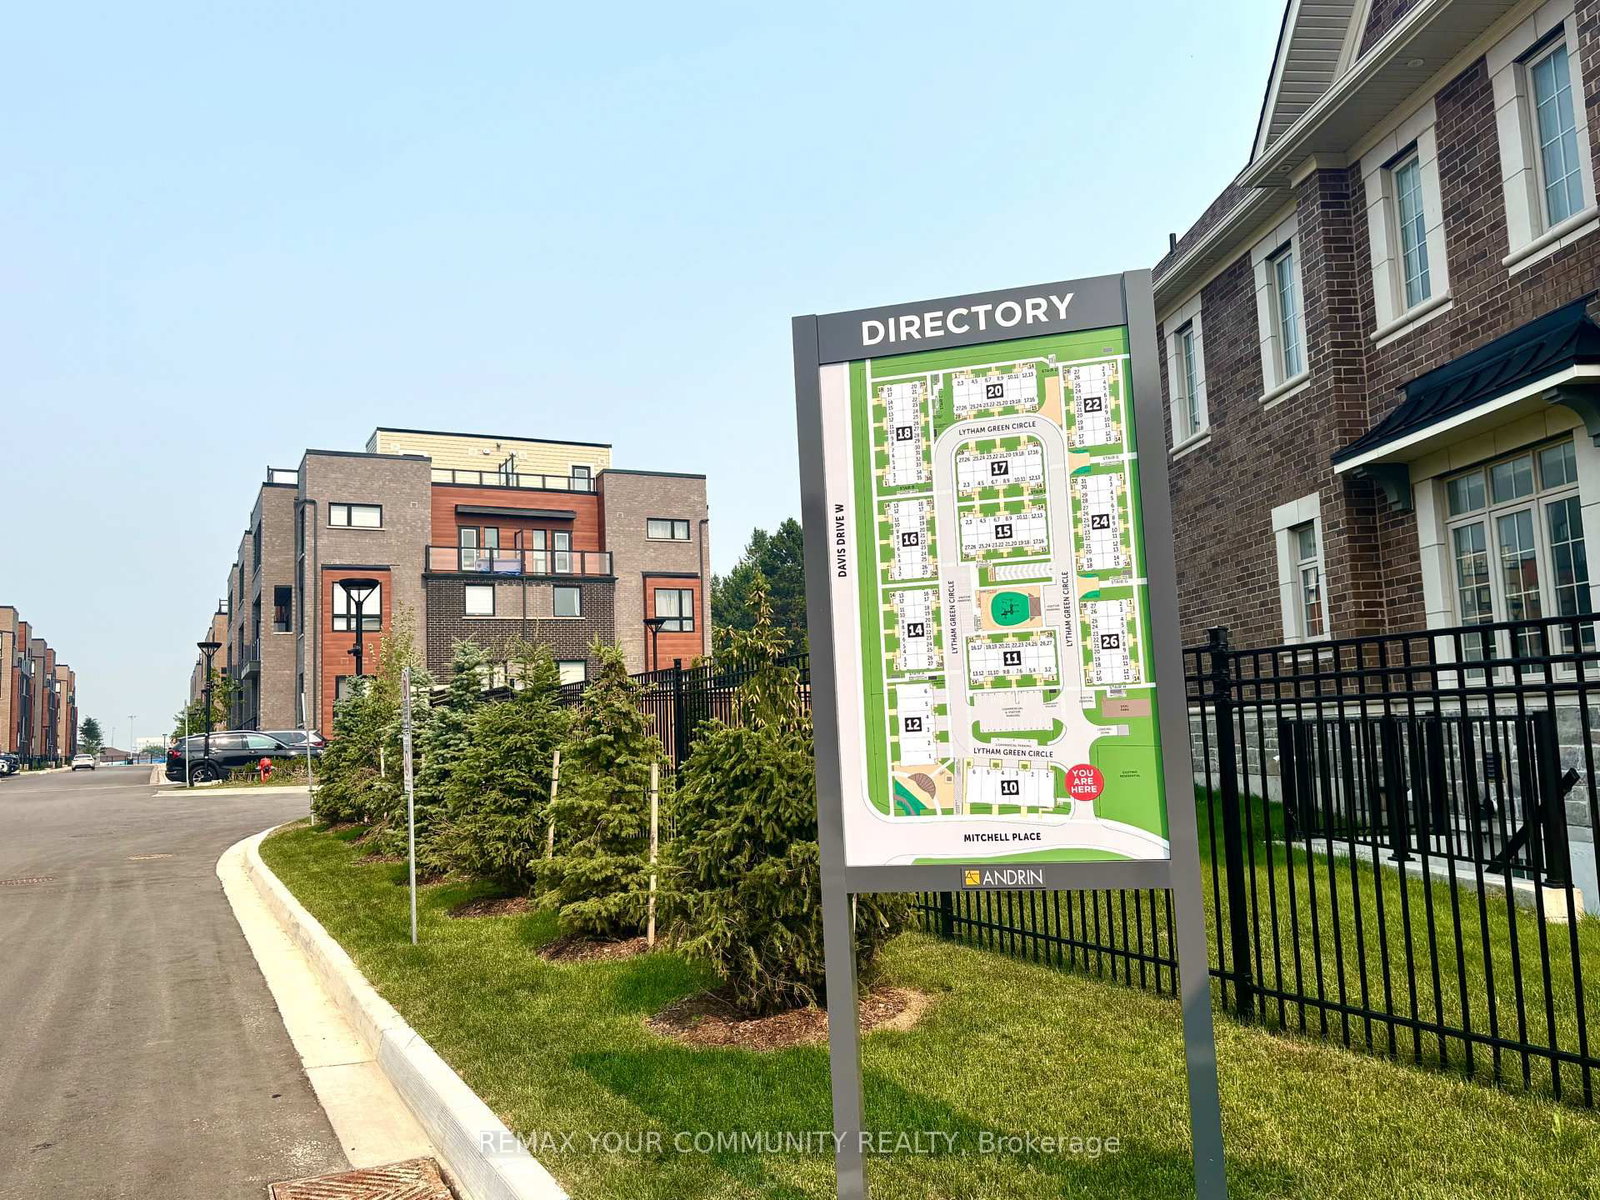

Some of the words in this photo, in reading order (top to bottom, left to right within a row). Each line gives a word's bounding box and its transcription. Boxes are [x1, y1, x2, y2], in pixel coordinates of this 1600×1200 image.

[862, 293, 1074, 346] DIRECTORY
[987, 386, 1002, 397] 20
[1086, 400, 1101, 411] 22
[898, 429, 911, 439] 18
[959, 427, 986, 436] LYTHAM
[988, 423, 1010, 432] GREEN
[1012, 421, 1036, 429] CIRCLE
[993, 463, 1007, 474] 17
[835, 504, 844, 513] W
[1093, 517, 1108, 528] 24
[836, 516, 845, 545] DRIVE
[997, 526, 1010, 538] 15
[904, 534, 917, 545] 16
[837, 548, 847, 577] DAVIS
[1063, 597, 1071, 618] GREEN
[909, 625, 923, 636] 14
[1065, 621, 1073, 647] LYTHAM
[1103, 636, 1118, 647] 26
[1005, 653, 1019, 664] 11
[907, 719, 920, 730] 12
[1003, 783, 1017, 793] 10
[964, 834, 1010, 842] MITCHELL
[1012, 832, 1041, 840] PLACE
[983, 869, 1043, 885] ANDRIN
